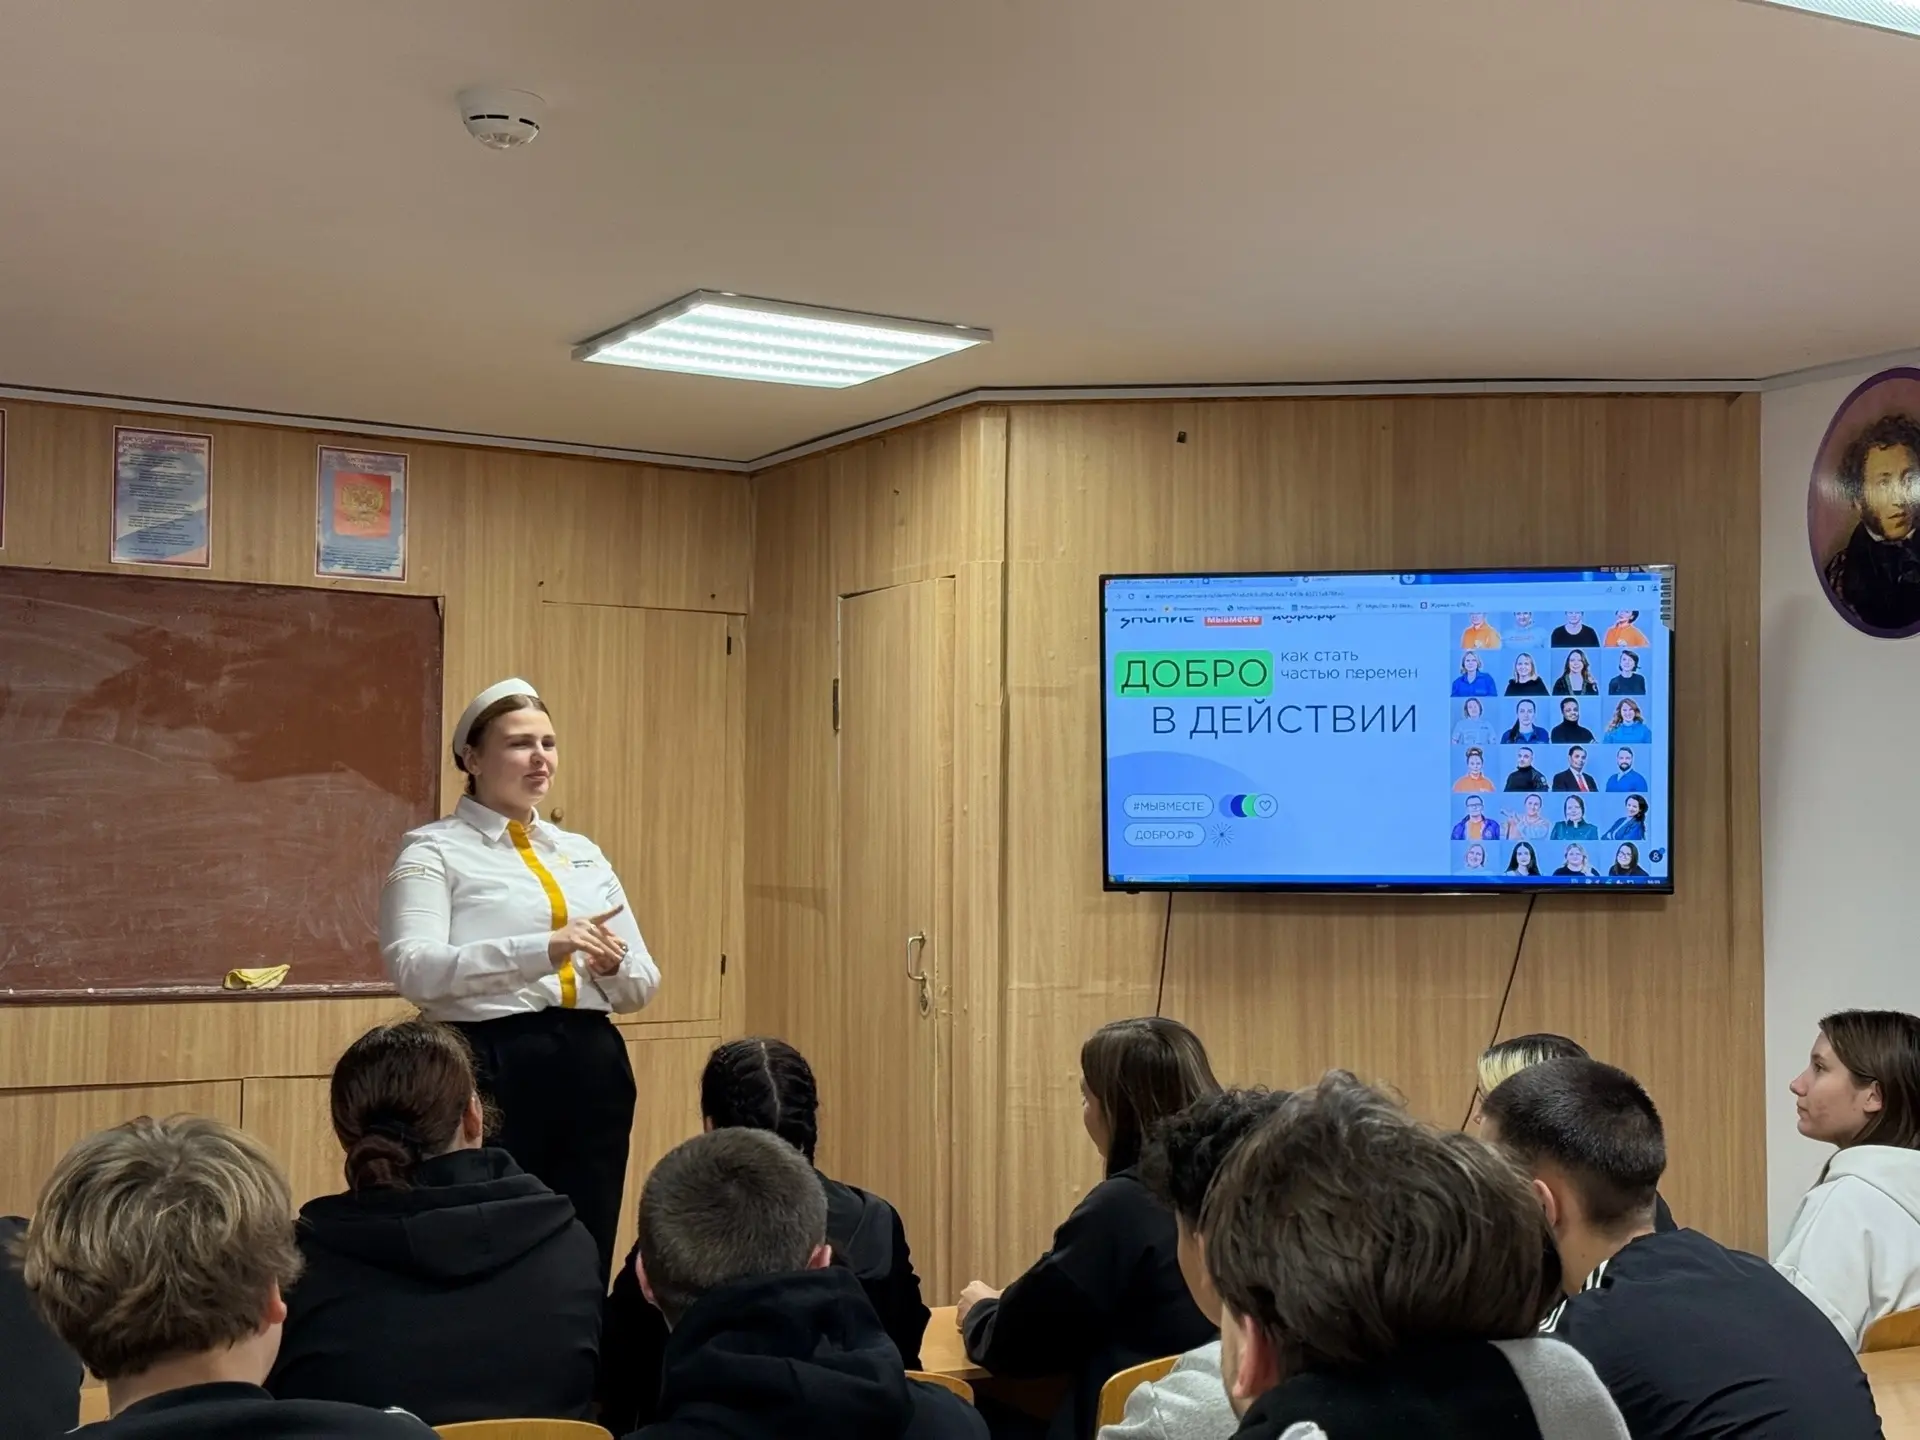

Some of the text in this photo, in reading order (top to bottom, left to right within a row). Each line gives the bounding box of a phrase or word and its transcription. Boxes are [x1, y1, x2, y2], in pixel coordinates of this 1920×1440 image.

[1281, 649, 1359, 662] как стать
[1121, 658, 1268, 693] ДОБРО
[1281, 667, 1418, 681] частью перемен
[1153, 698, 1417, 740] В ДЕЙСТВИИ
[1133, 801, 1204, 811] #МЫВМЕСТЕ
[1135, 829, 1194, 840] ДОБРО.РФ
